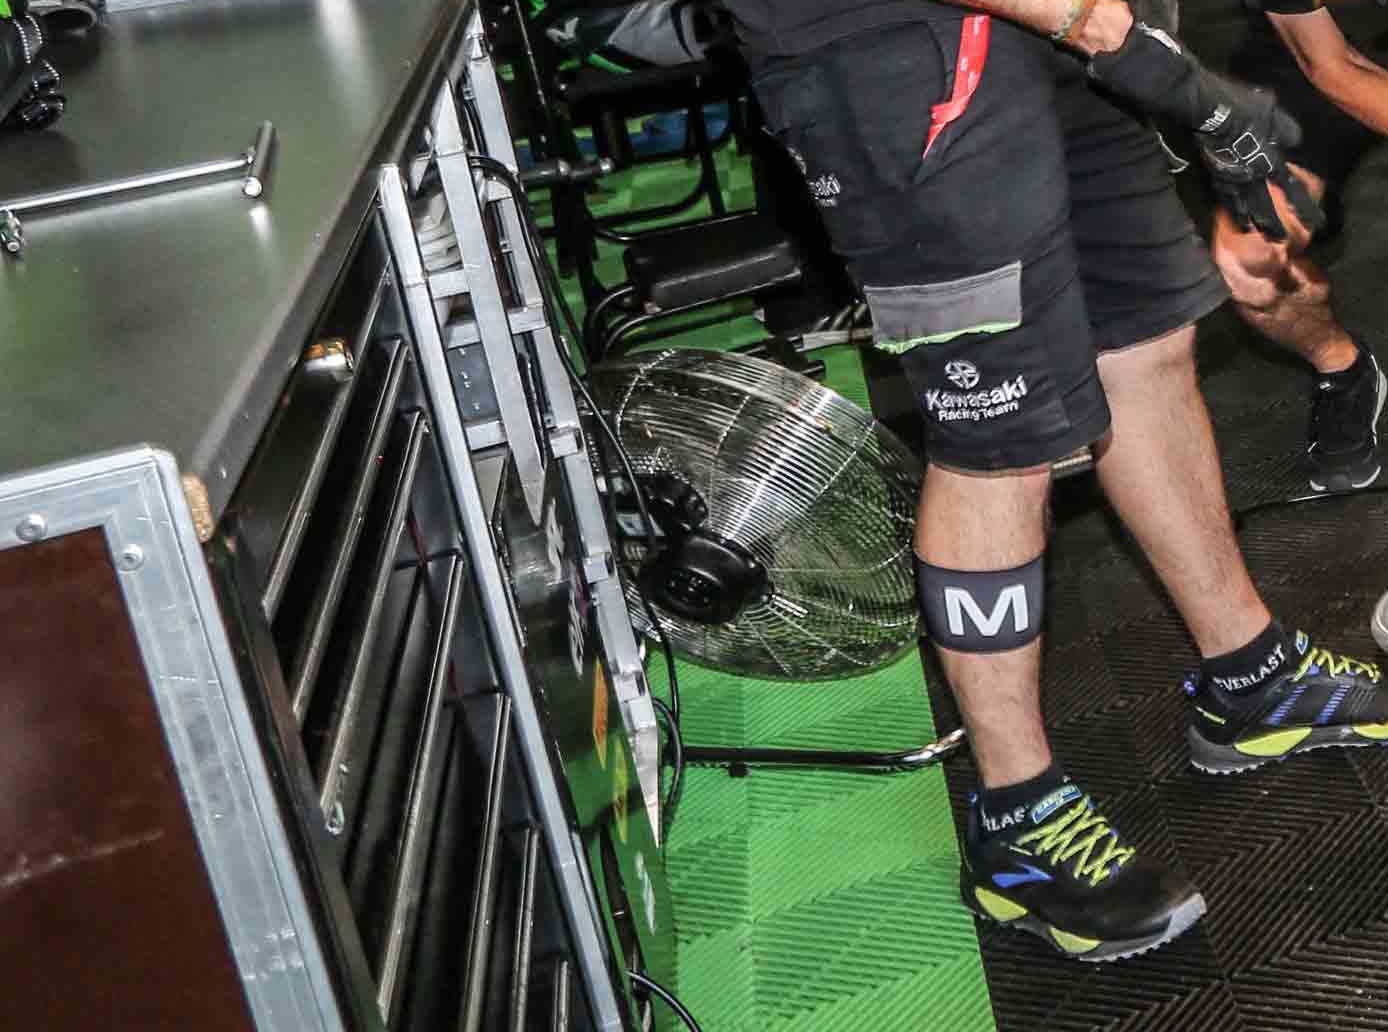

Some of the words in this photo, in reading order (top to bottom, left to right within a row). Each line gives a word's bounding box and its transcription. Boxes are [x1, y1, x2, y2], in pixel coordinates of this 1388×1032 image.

[926, 375, 1028, 411] Kawasaki
[938, 405, 980, 422] Racing
[980, 399, 1020, 419] Team
[944, 582, 1031, 638] M
